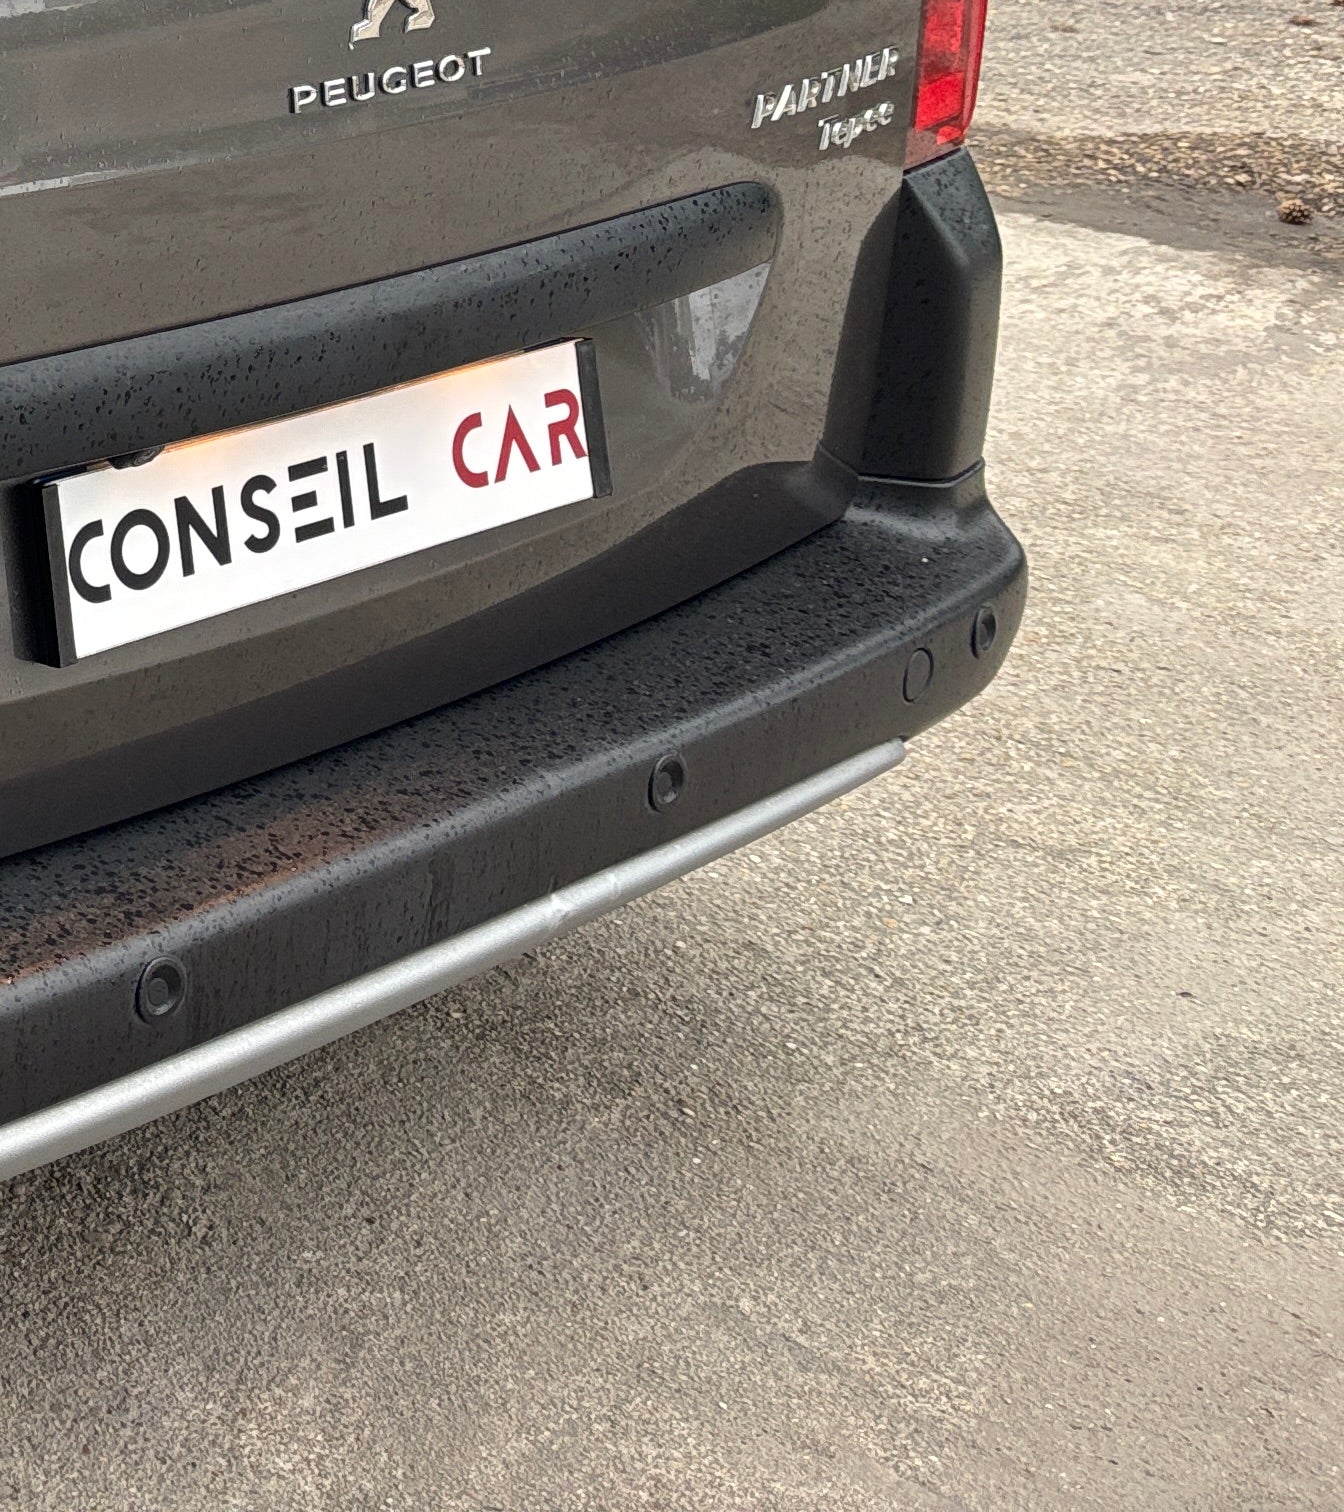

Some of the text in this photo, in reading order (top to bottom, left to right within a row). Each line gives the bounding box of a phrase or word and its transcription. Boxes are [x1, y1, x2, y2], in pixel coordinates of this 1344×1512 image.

[290, 46, 492, 114] PEUGEOT
[750, 44, 900, 129] PARTNER
[817, 100, 896, 151] Tepee
[67, 387, 588, 604] CONSEIL CAR
